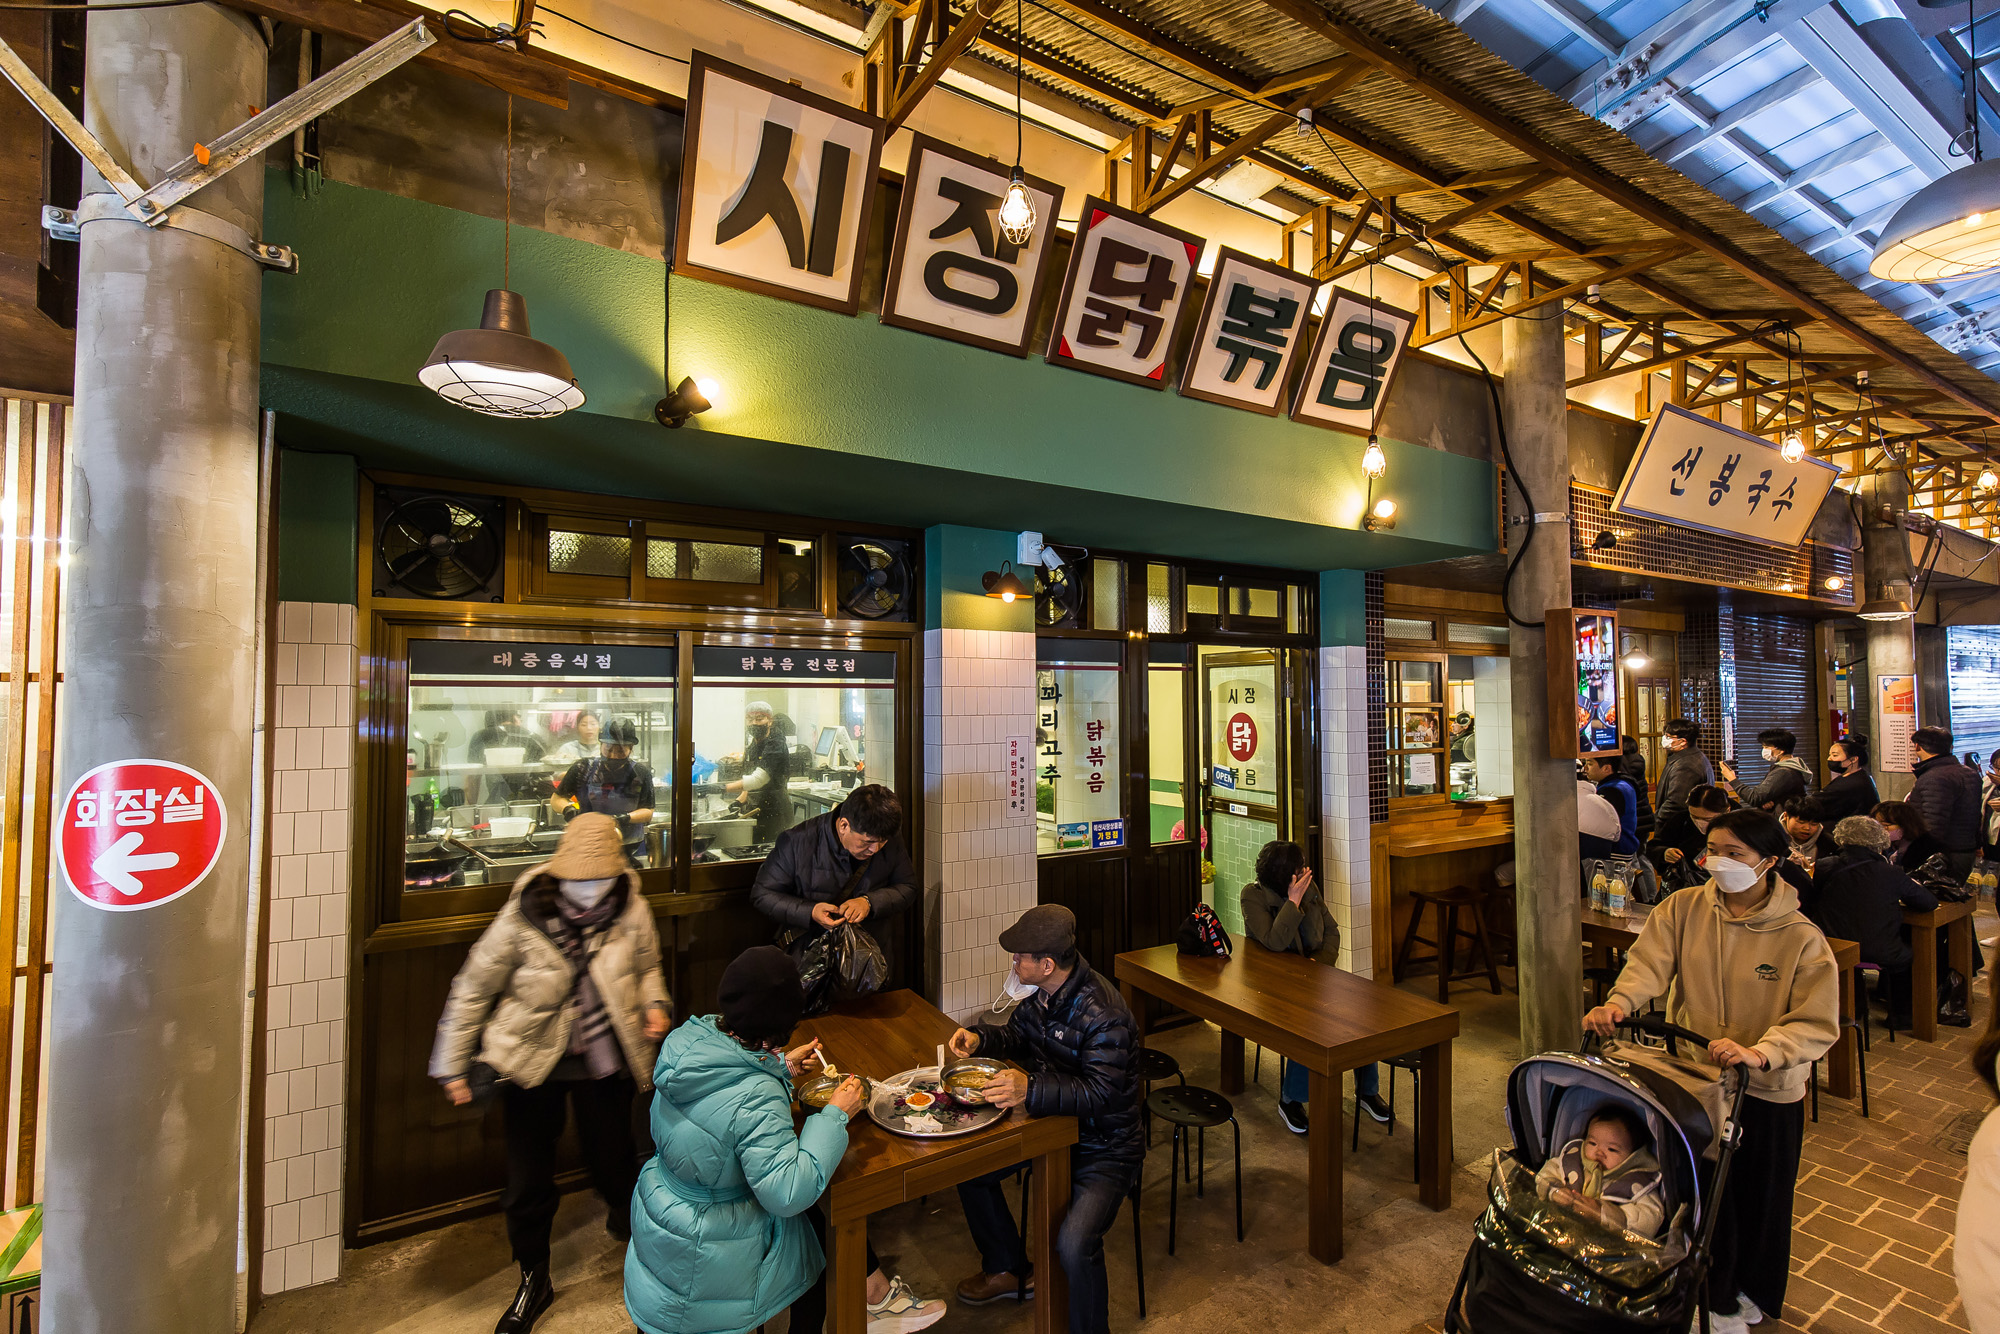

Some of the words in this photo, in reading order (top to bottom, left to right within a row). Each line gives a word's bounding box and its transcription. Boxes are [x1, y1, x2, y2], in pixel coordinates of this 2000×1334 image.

[1669, 446, 1798, 522] 선봉국수
[493, 651, 612, 669] 대중음식점
[741, 656, 795, 671] 닭볶음
[806, 657, 855, 672] 전문점
[1228, 687, 1256, 704] 시장
[1040, 682, 1063, 785] 꽈리고추
[1232, 722, 1251, 752] 닭
[1010, 740, 1017, 757] 자리
[1086, 719, 1107, 793] 닭볶음
[1010, 760, 1017, 777] 먼저
[1215, 770, 1233, 784] OPEN
[1010, 780, 1017, 797] 확보
[74, 784, 204, 828] 화장실
[1010, 800, 1018, 809] 후
[1097, 830, 1119, 841] 가맹점
